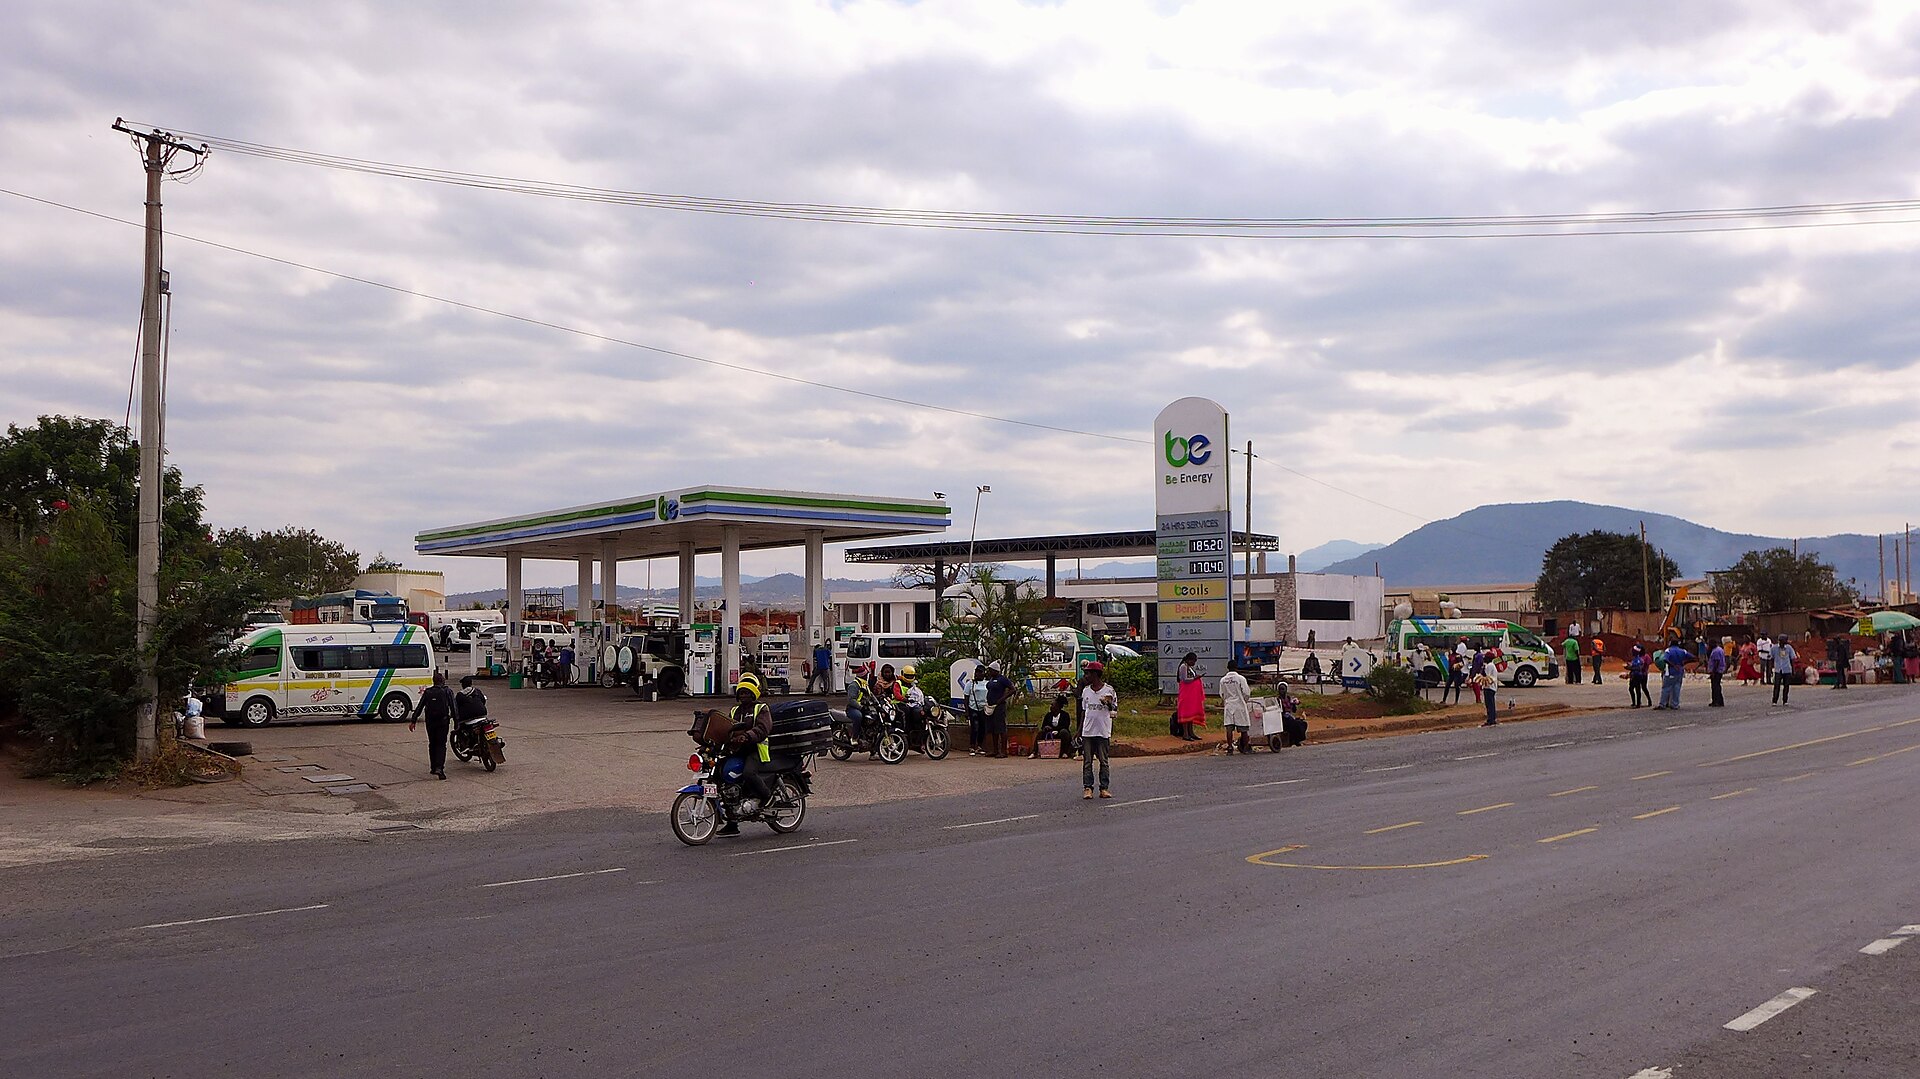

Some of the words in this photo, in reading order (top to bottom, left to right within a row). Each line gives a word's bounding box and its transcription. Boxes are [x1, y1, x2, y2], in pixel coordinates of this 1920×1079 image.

[1165, 475, 1178, 485] Be
[1180, 473, 1213, 484] Energy
[1161, 522, 1170, 531] 24
[1171, 521, 1185, 530] HRS
[1186, 519, 1219, 529] SERVICES
[828, 602, 833, 610] 2
[1175, 603, 1208, 614] Benefit
